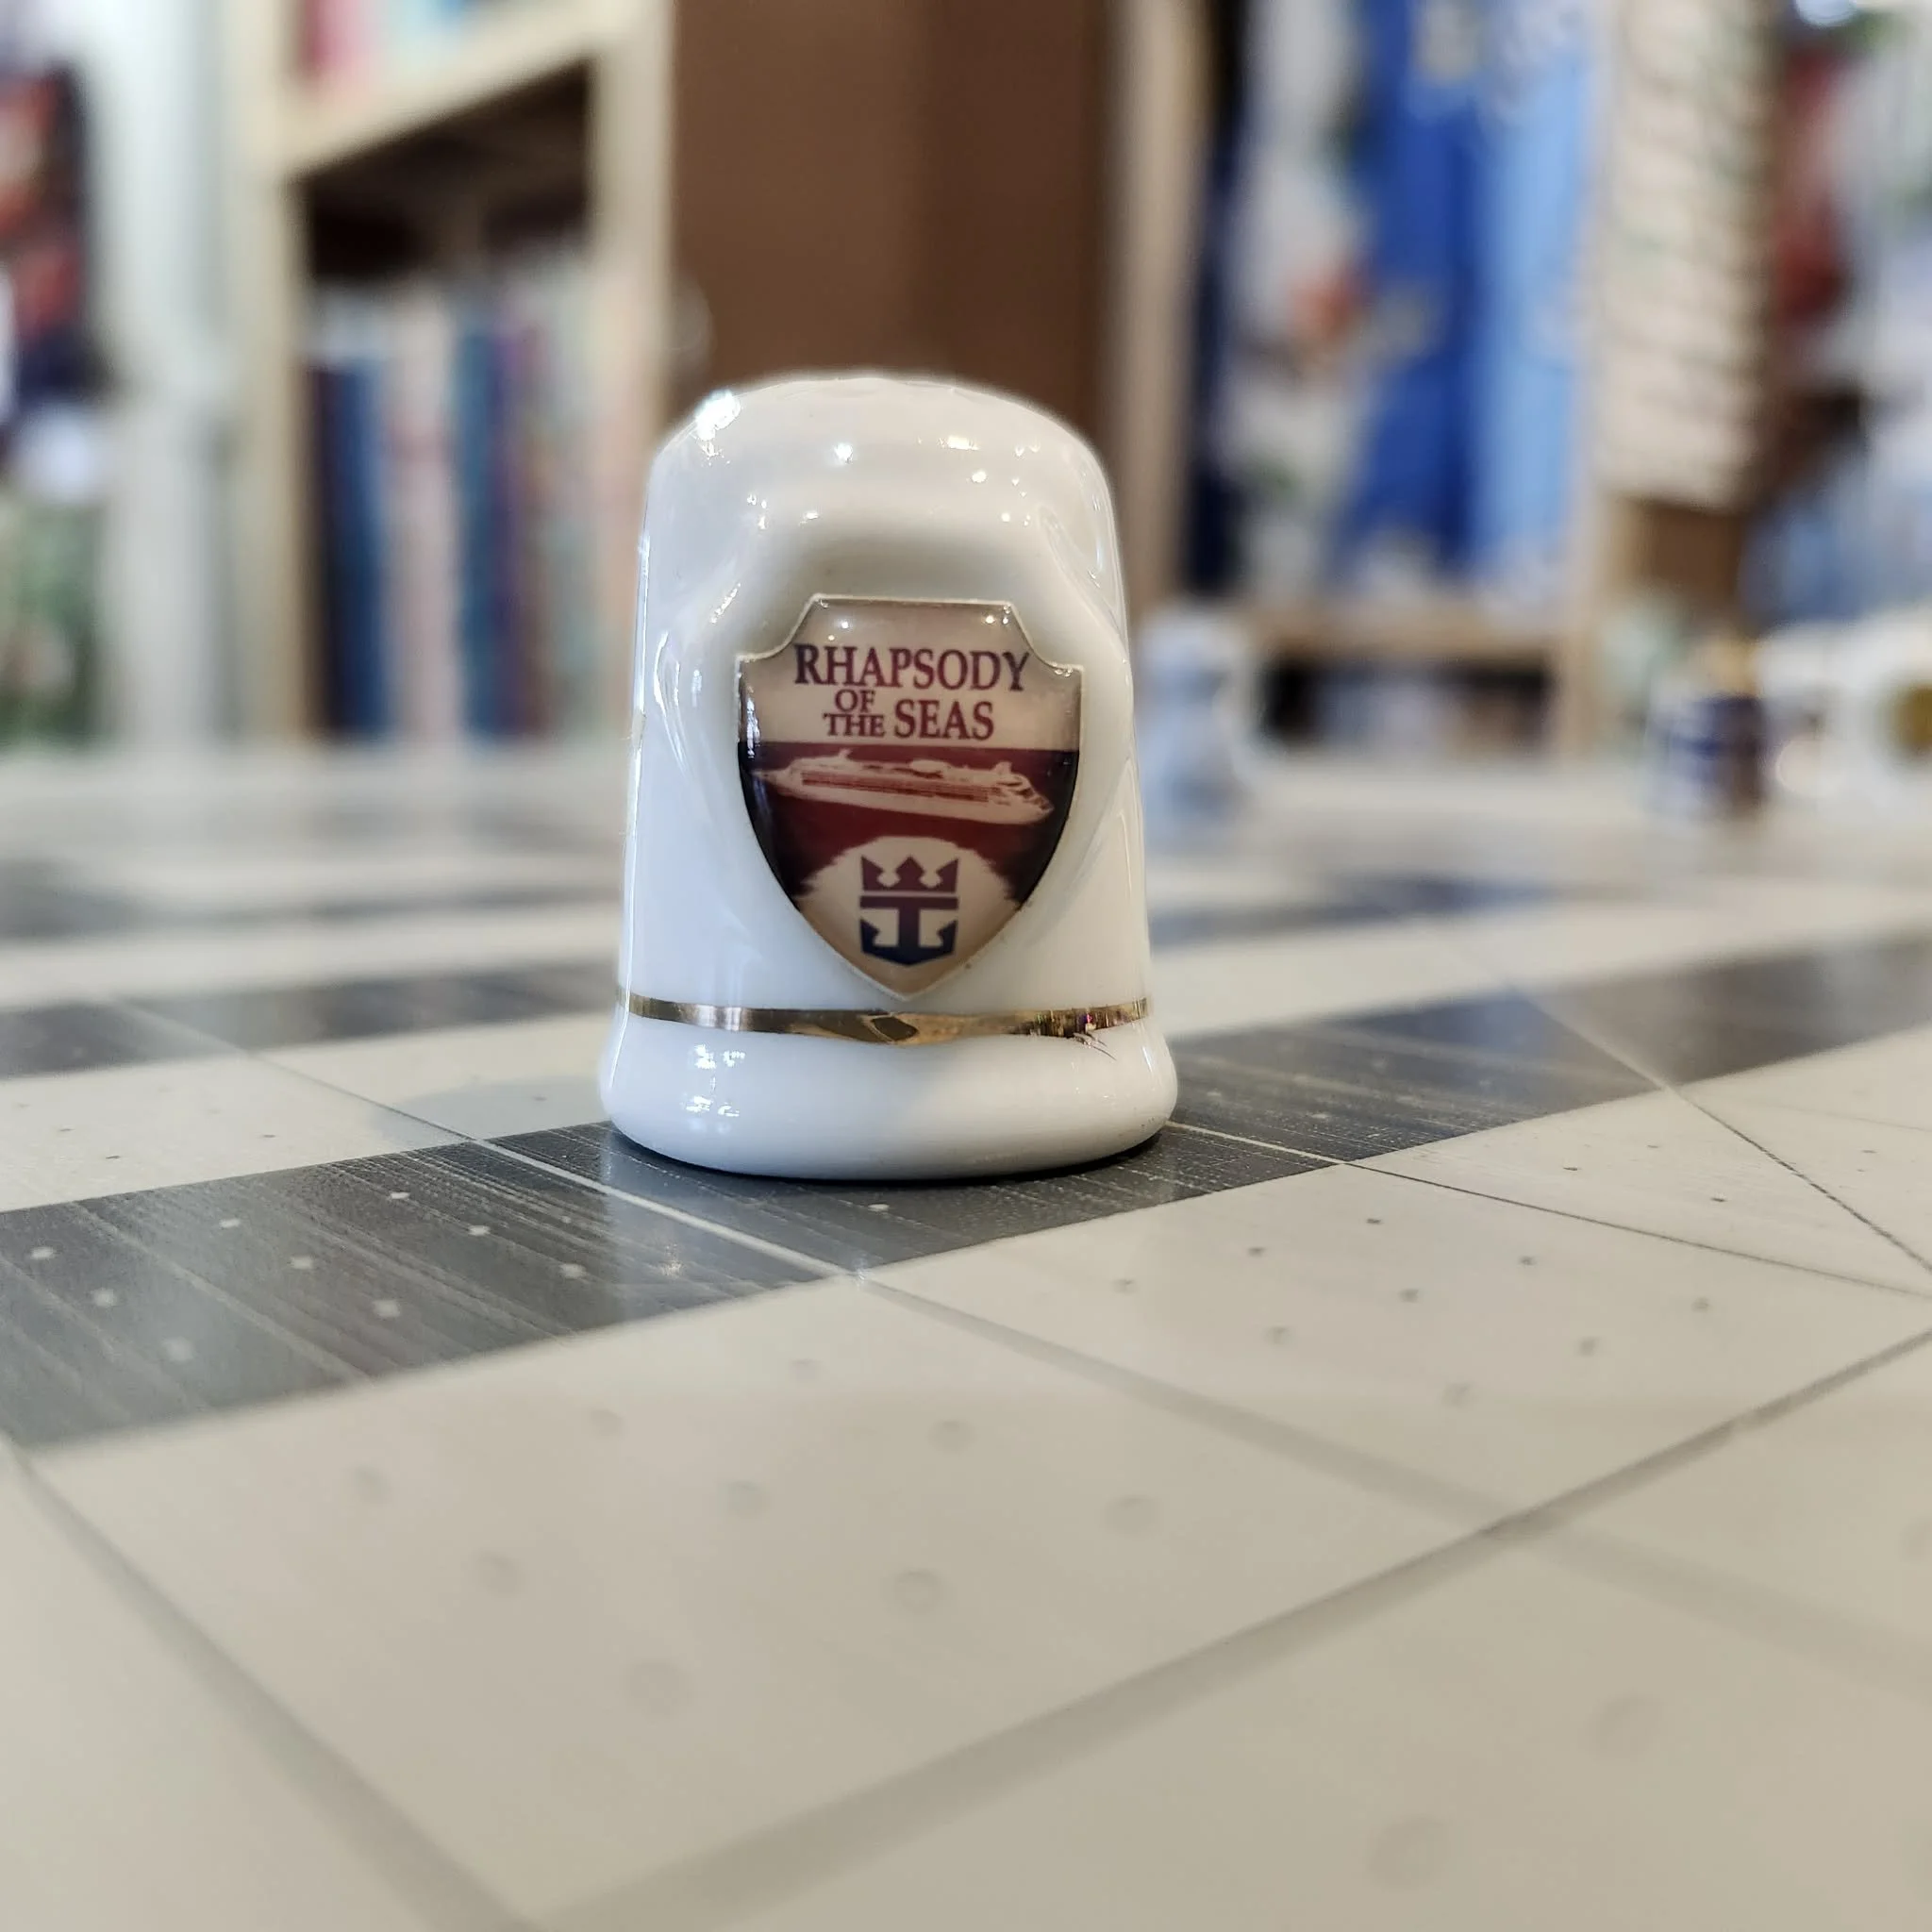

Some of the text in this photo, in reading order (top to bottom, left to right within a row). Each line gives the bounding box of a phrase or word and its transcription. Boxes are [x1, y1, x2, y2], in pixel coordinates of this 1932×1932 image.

[793, 643, 1030, 691] RHAPSODY
[823, 698, 994, 741] THE SEAS
[834, 689, 876, 713] OF
